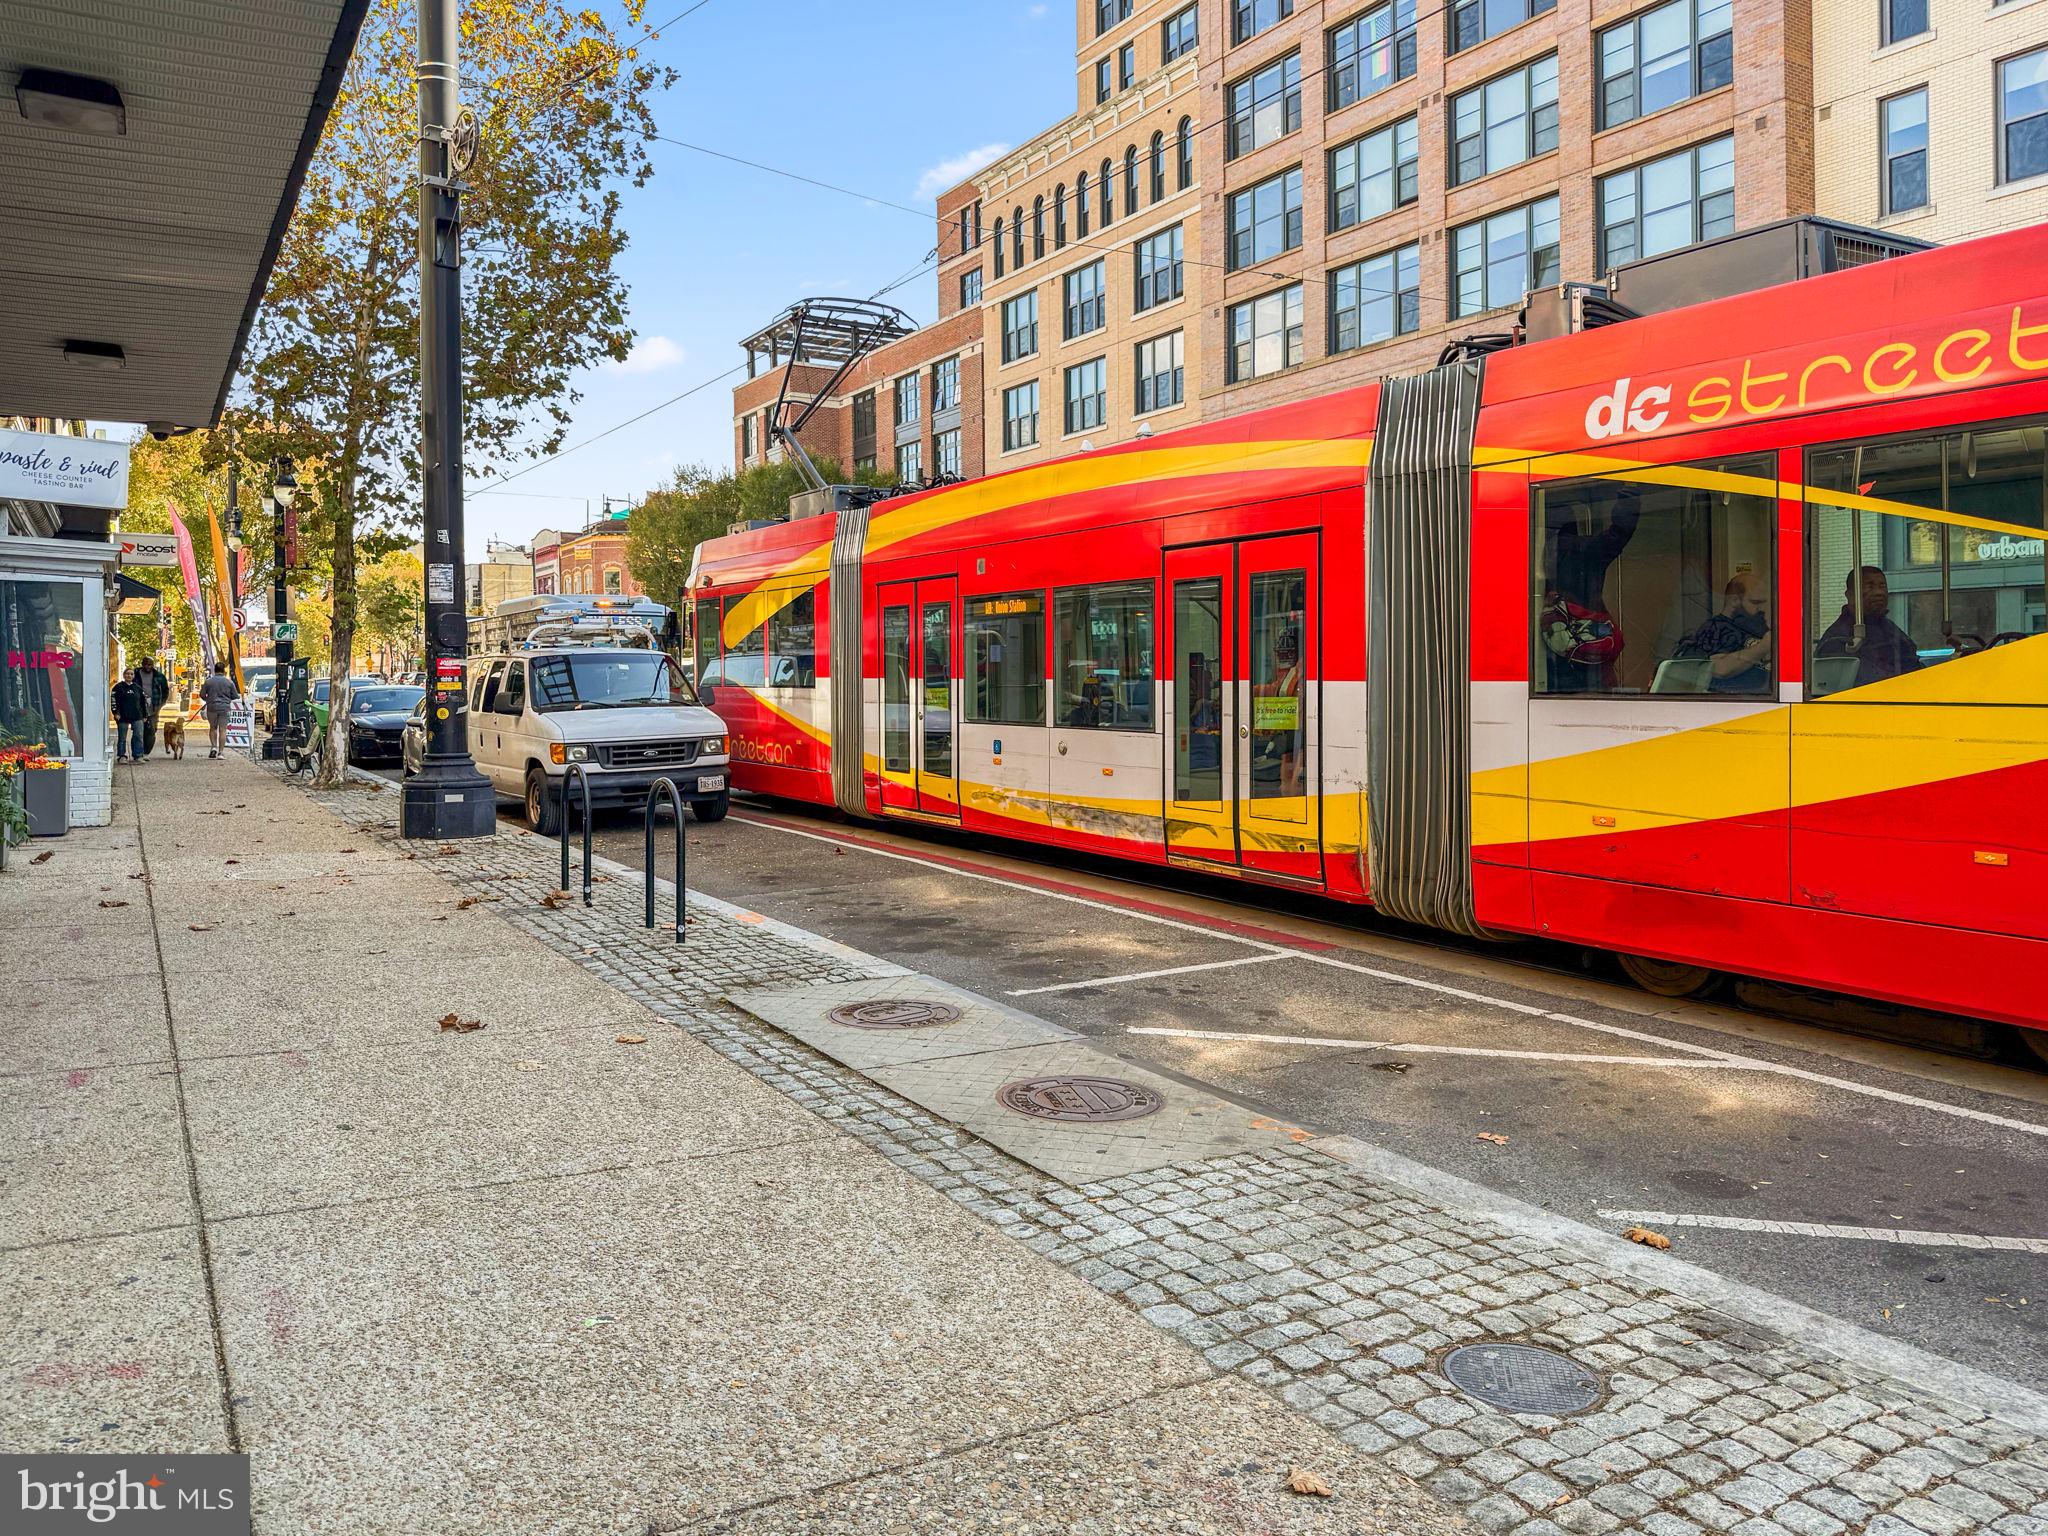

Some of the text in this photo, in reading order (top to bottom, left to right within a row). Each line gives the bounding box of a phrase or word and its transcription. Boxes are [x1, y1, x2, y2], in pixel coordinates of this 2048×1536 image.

[1585, 378, 1672, 440] dc
[59, 457, 72, 471] &
[80, 460, 119, 479] rind
[22, 471, 93, 483] CHEESE COUNTER
[34, 479, 66, 488] TASTING
[137, 543, 176, 553] boost
[1978, 536, 2045, 560] urban
[1009, 599, 1027, 612] Station
[298, 668, 306, 678] P
[731, 736, 792, 763] reetcar
